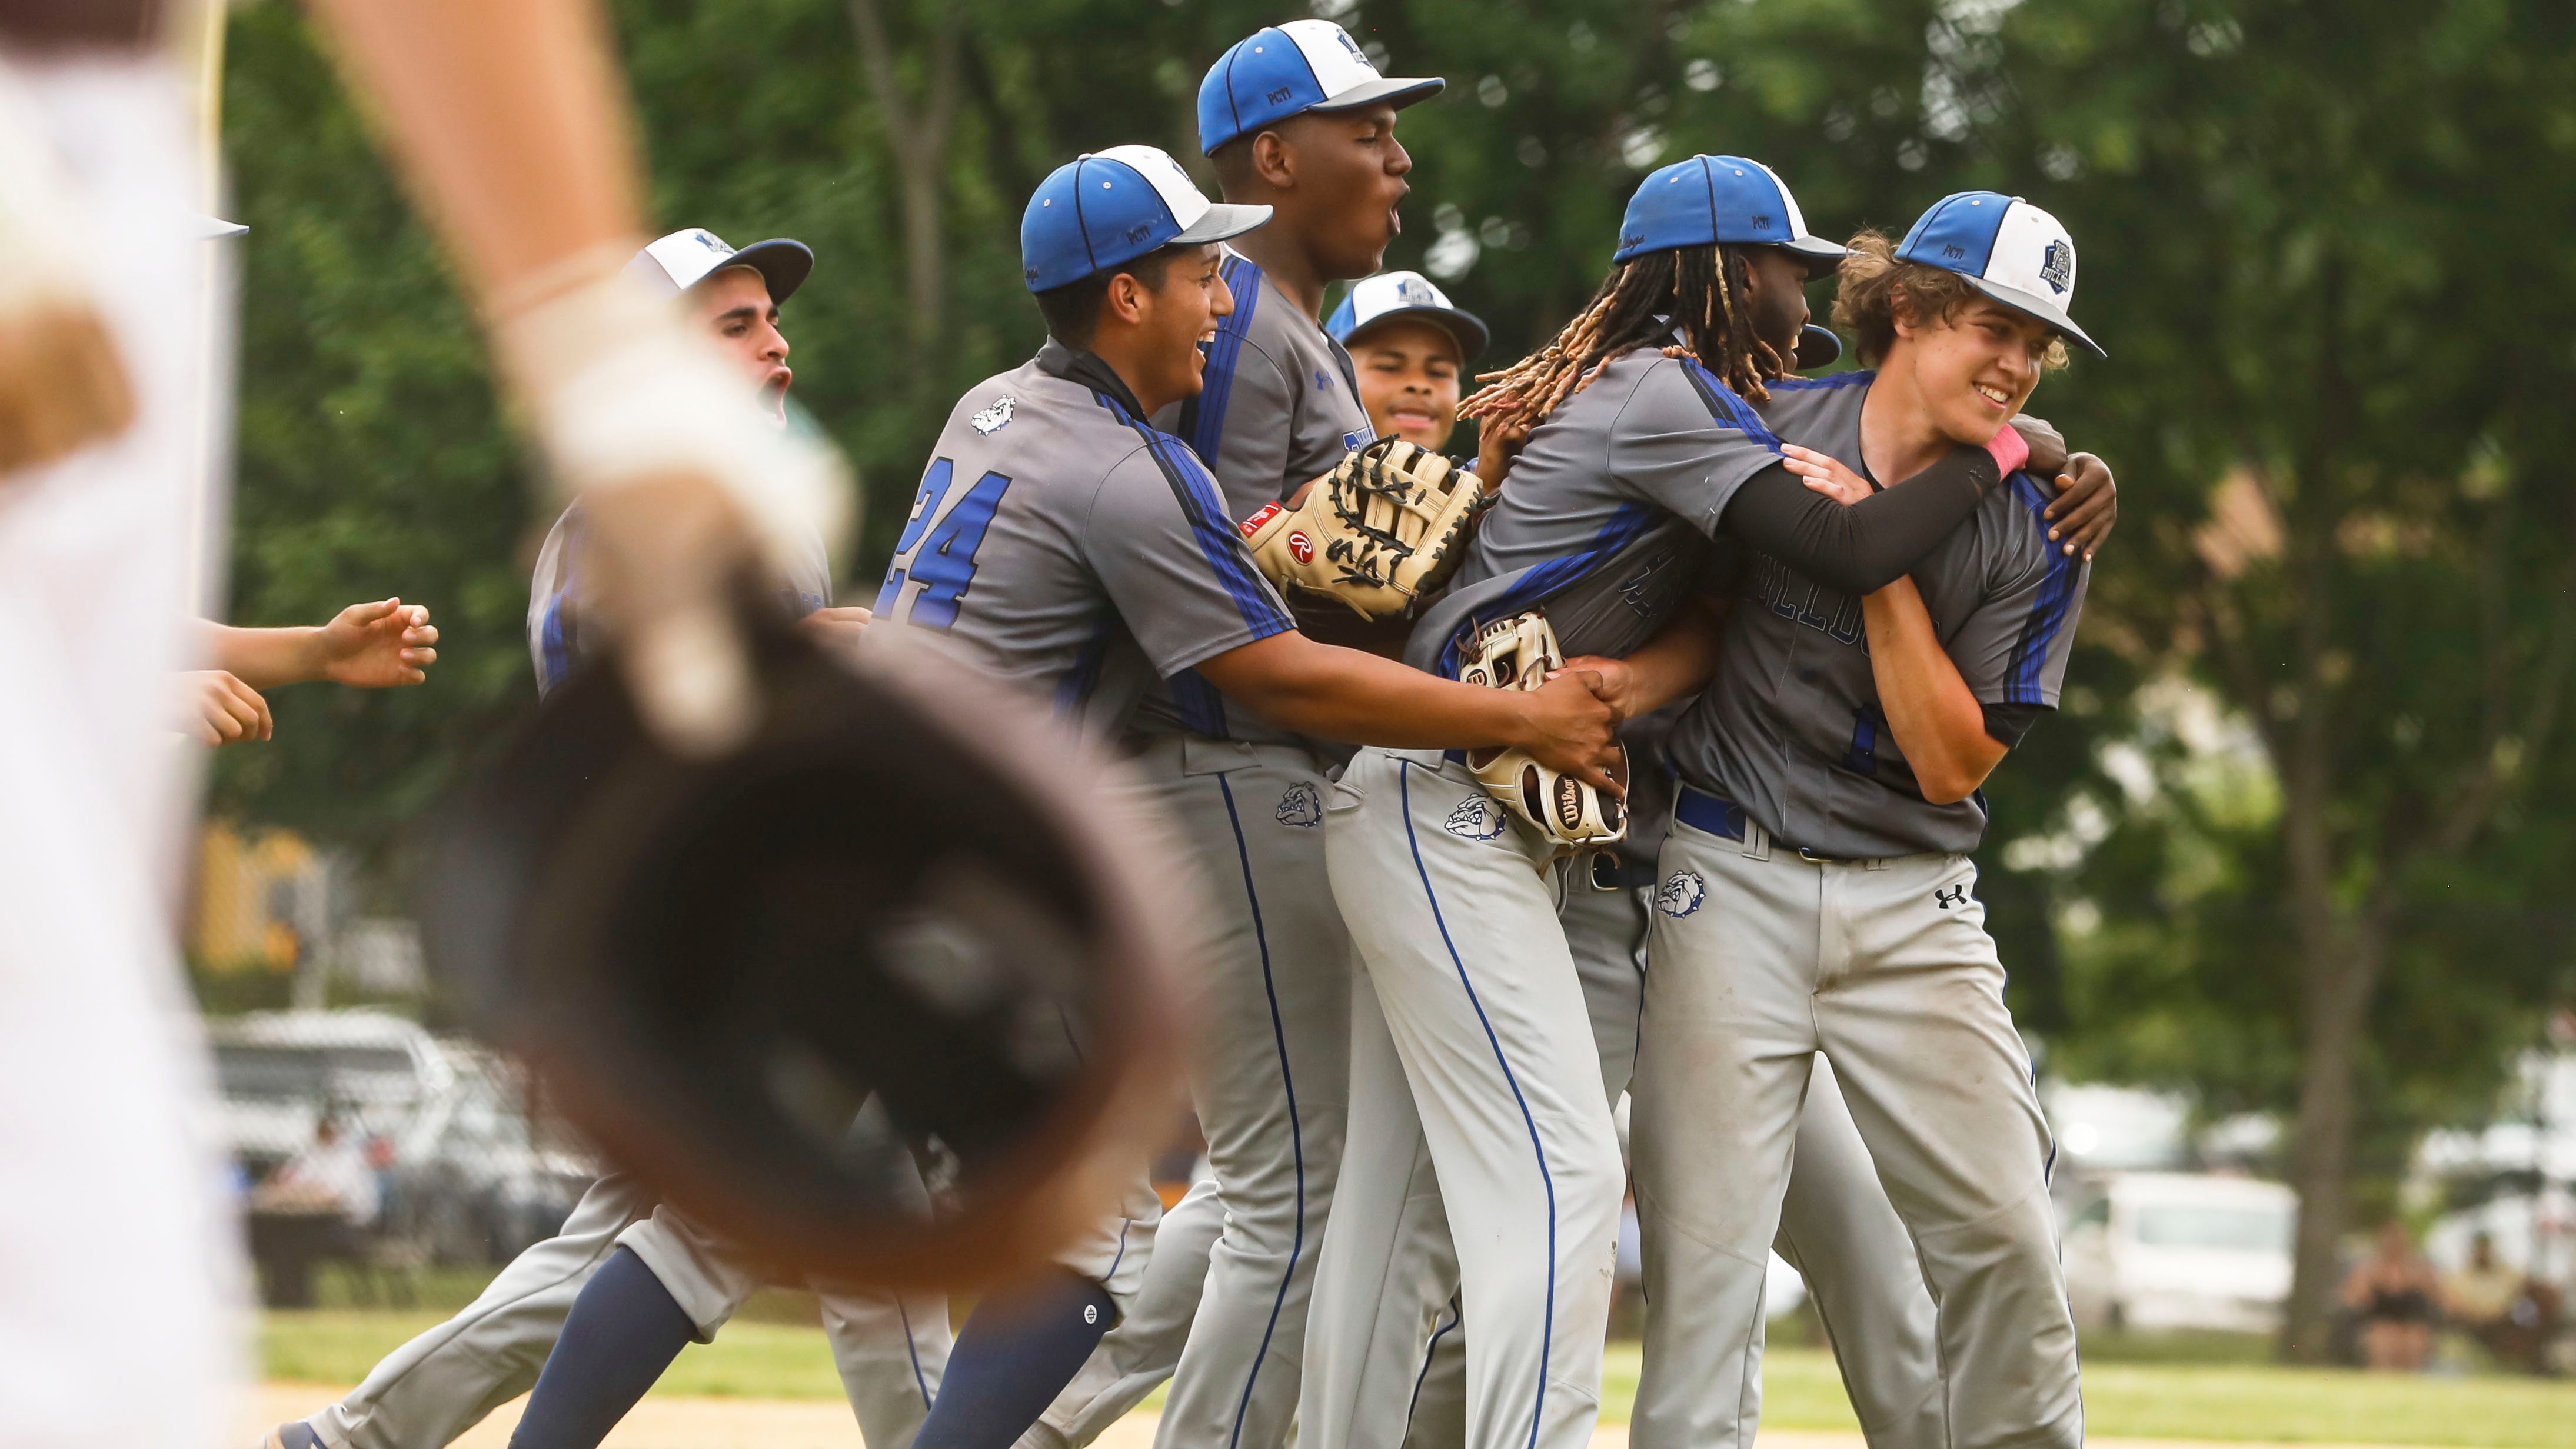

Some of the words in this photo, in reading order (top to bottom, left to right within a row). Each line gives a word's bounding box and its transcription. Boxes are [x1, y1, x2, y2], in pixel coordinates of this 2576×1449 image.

[1266, 86, 1293, 106] PCTI
[1751, 216, 1769, 230] PCTI
[1126, 225, 1151, 245] PCTI
[1942, 244, 1965, 259] PCTI
[871, 456, 1013, 634] 24
[1560, 779, 1579, 825] Wilson
